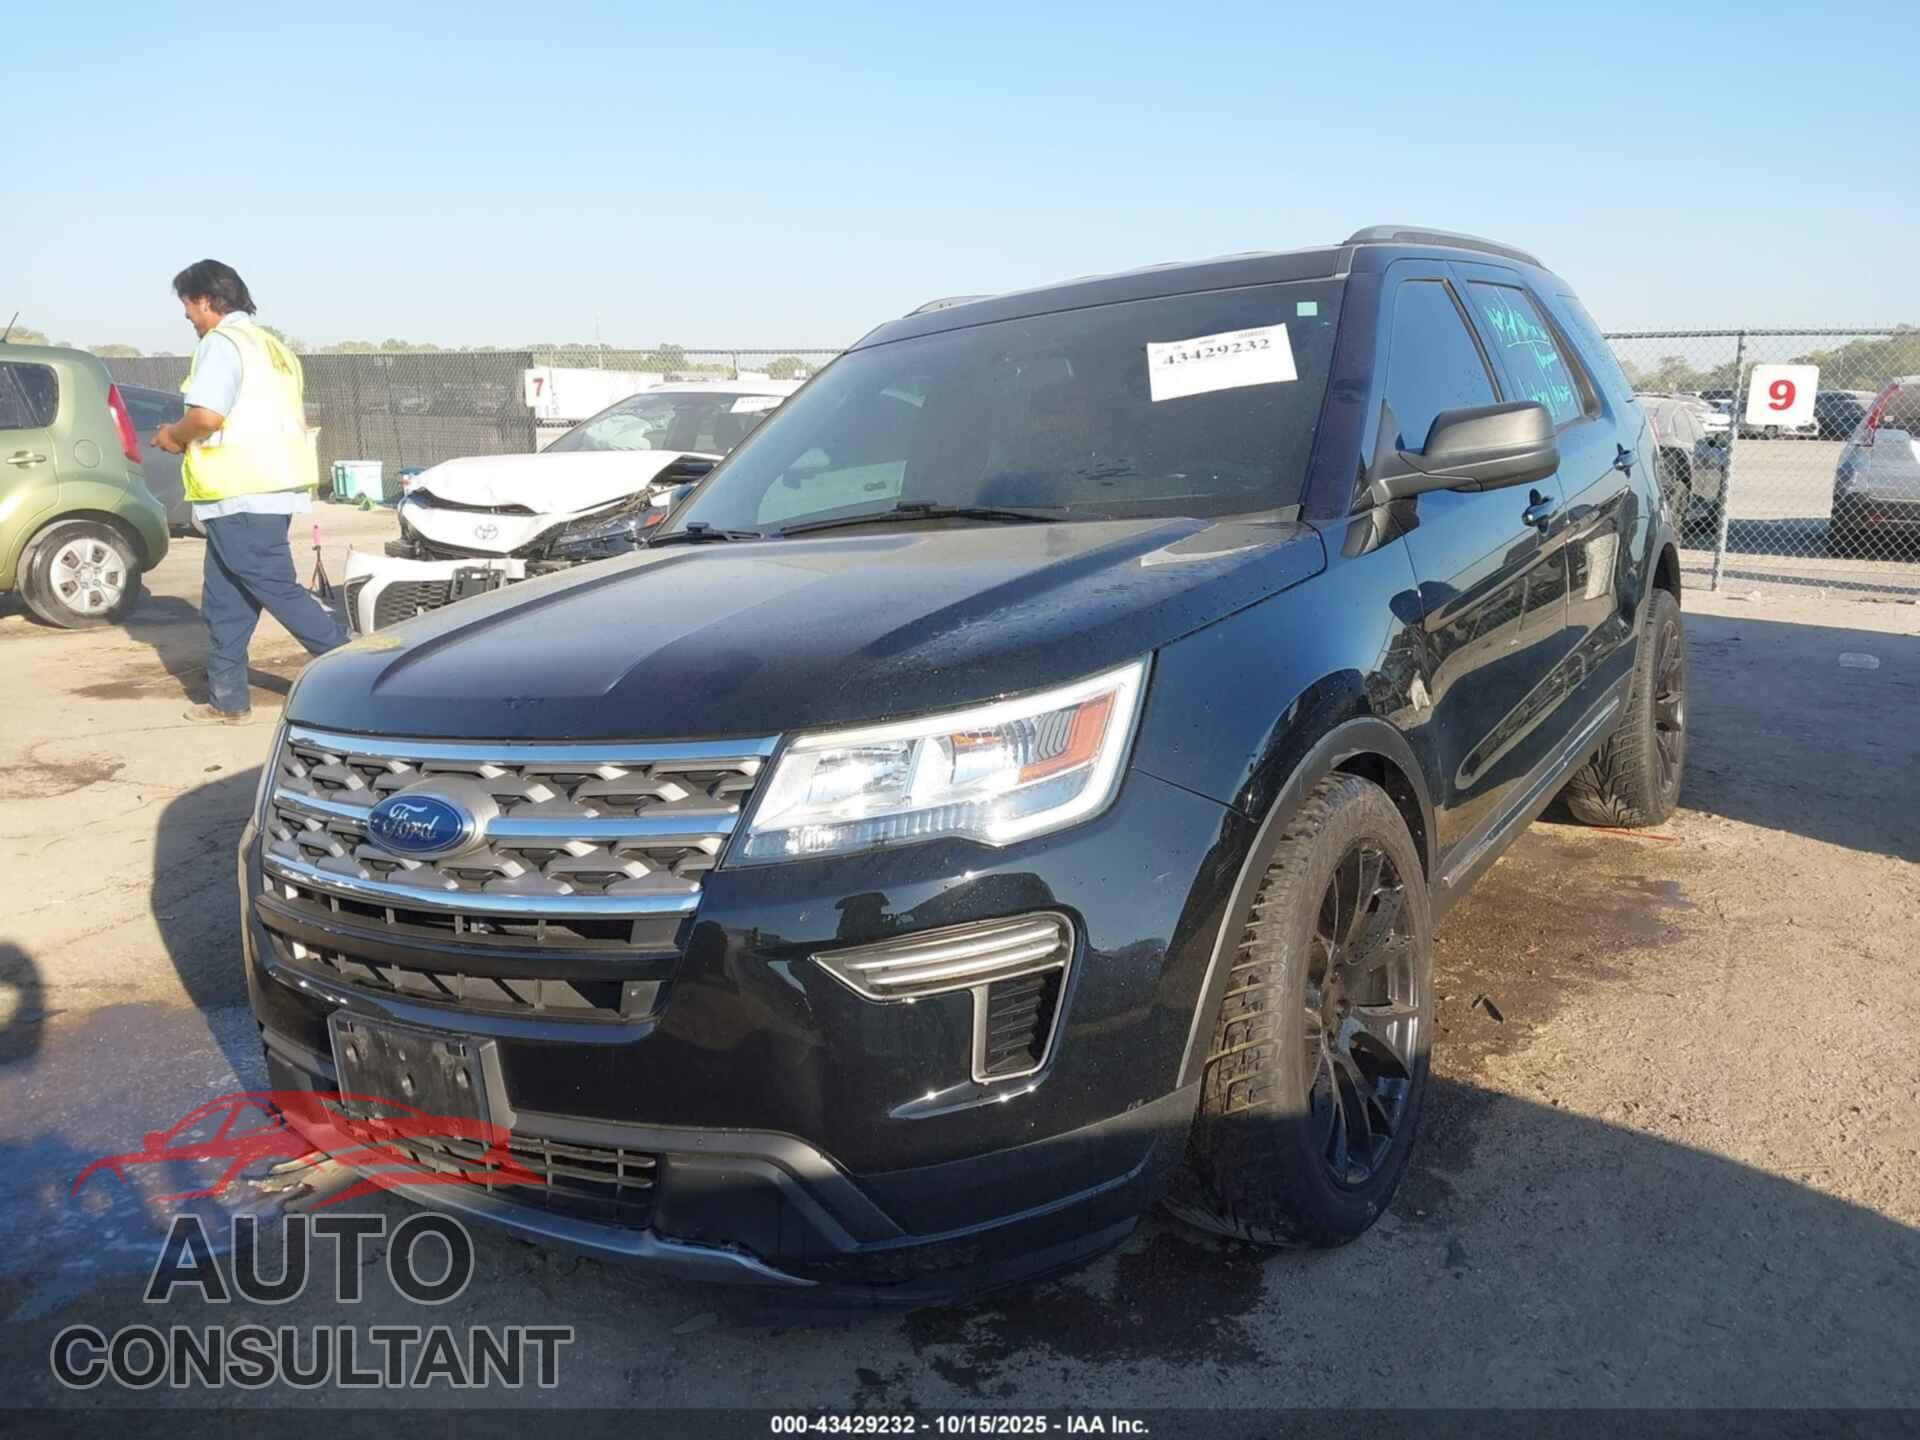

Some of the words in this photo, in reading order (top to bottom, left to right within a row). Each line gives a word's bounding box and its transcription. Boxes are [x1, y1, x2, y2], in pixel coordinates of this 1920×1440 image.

[1163, 338, 1271, 365] 43429232
[532, 377, 544, 397] 7
[1768, 380, 1796, 411] 9
[384, 803, 438, 839] Ford
